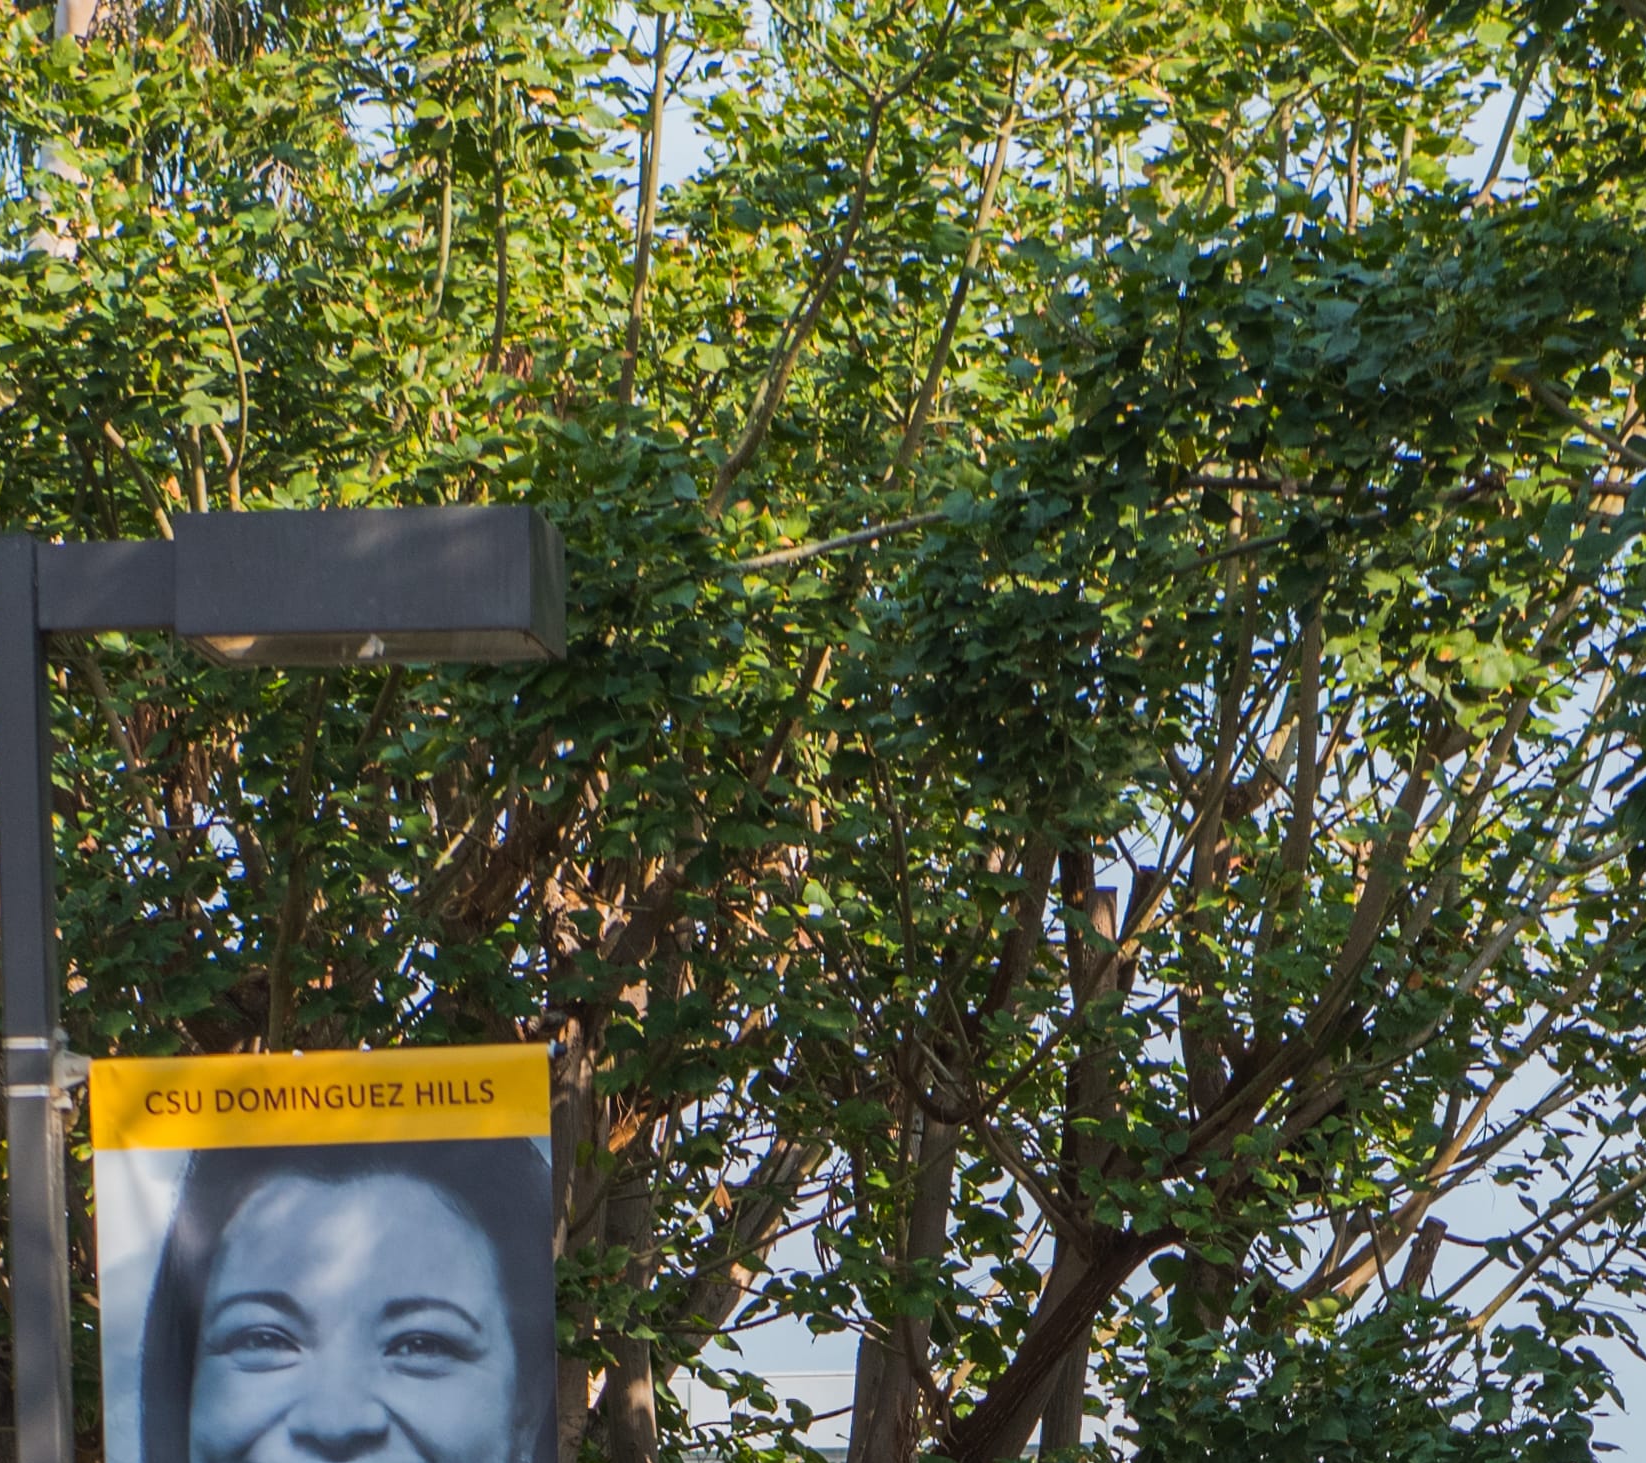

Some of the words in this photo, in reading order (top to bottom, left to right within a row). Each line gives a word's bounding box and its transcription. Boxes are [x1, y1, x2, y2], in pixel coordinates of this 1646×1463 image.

[145, 1090, 203, 1115] CSU
[216, 1083, 404, 1114] DOMINGUEZ
[416, 1078, 495, 1106] HILLS
